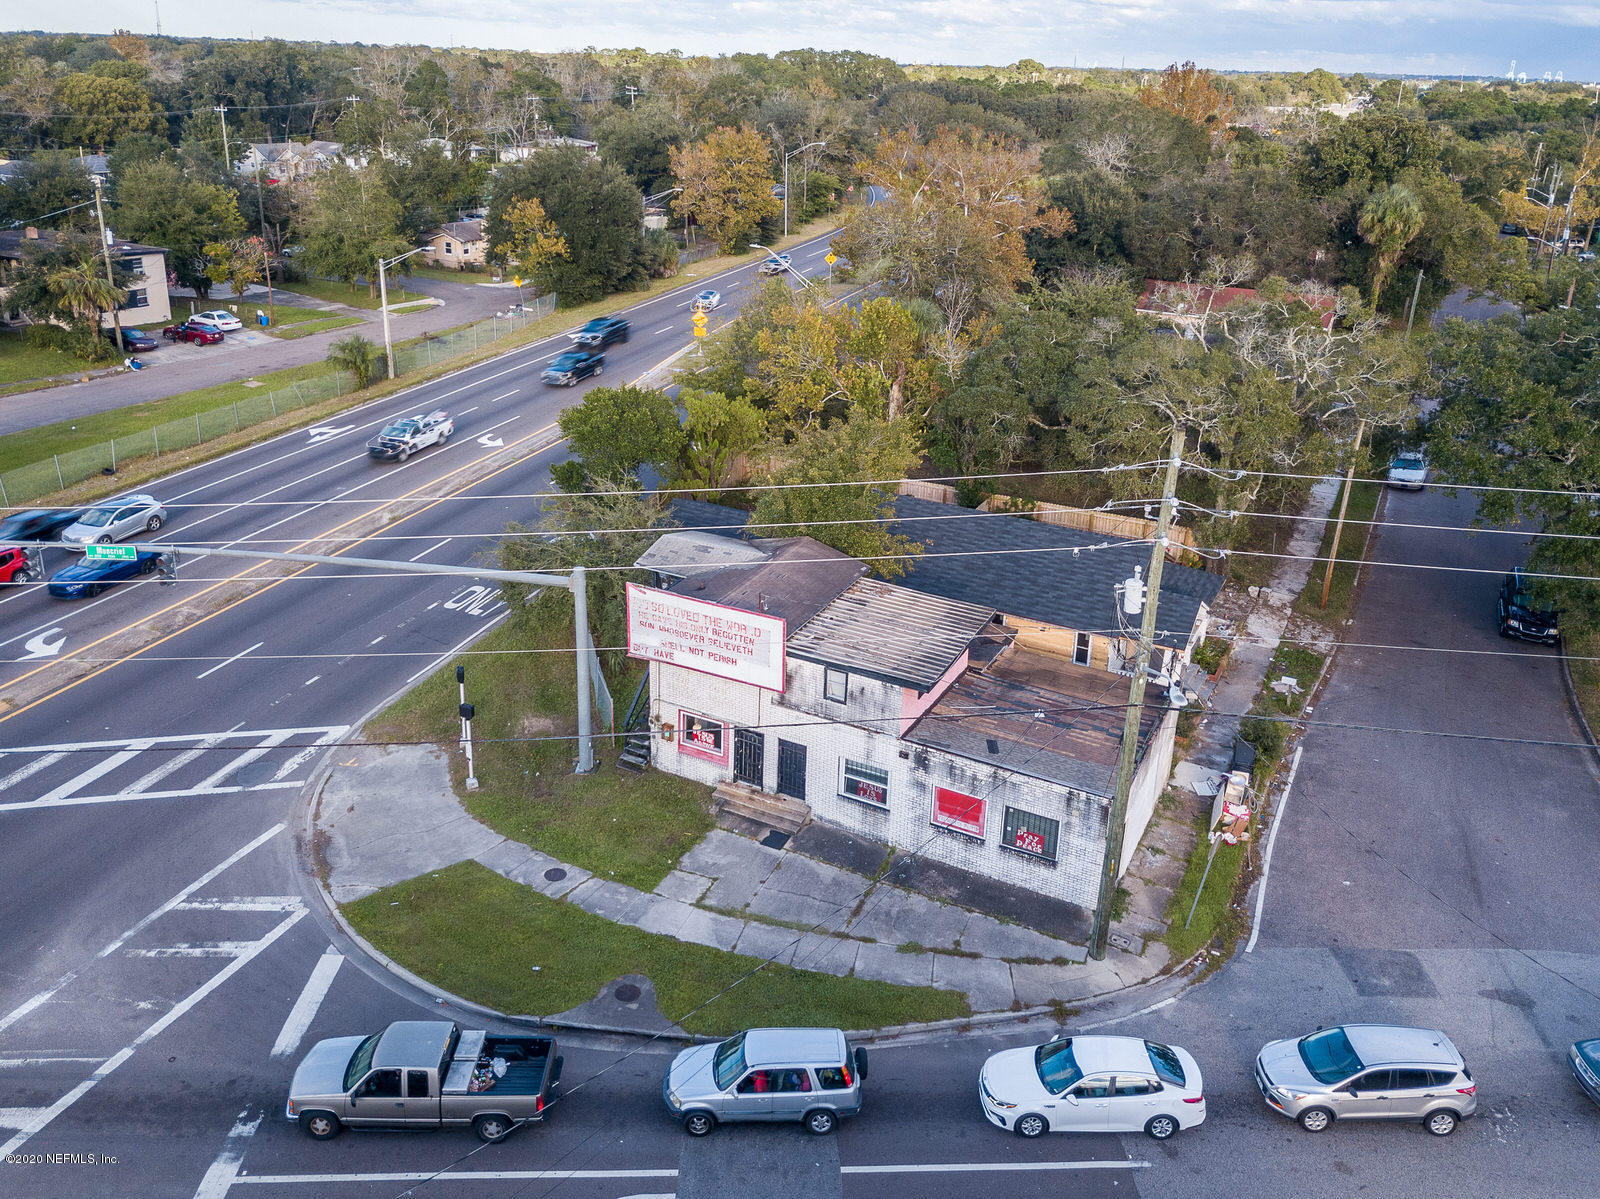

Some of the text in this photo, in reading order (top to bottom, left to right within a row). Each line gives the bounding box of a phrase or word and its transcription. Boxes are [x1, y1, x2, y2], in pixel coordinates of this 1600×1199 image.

[702, 614, 723, 628] THE
[712, 628, 755, 646] BEGOTTEN
[653, 648, 675, 661] HAVE
[689, 646, 704, 657] NOT
